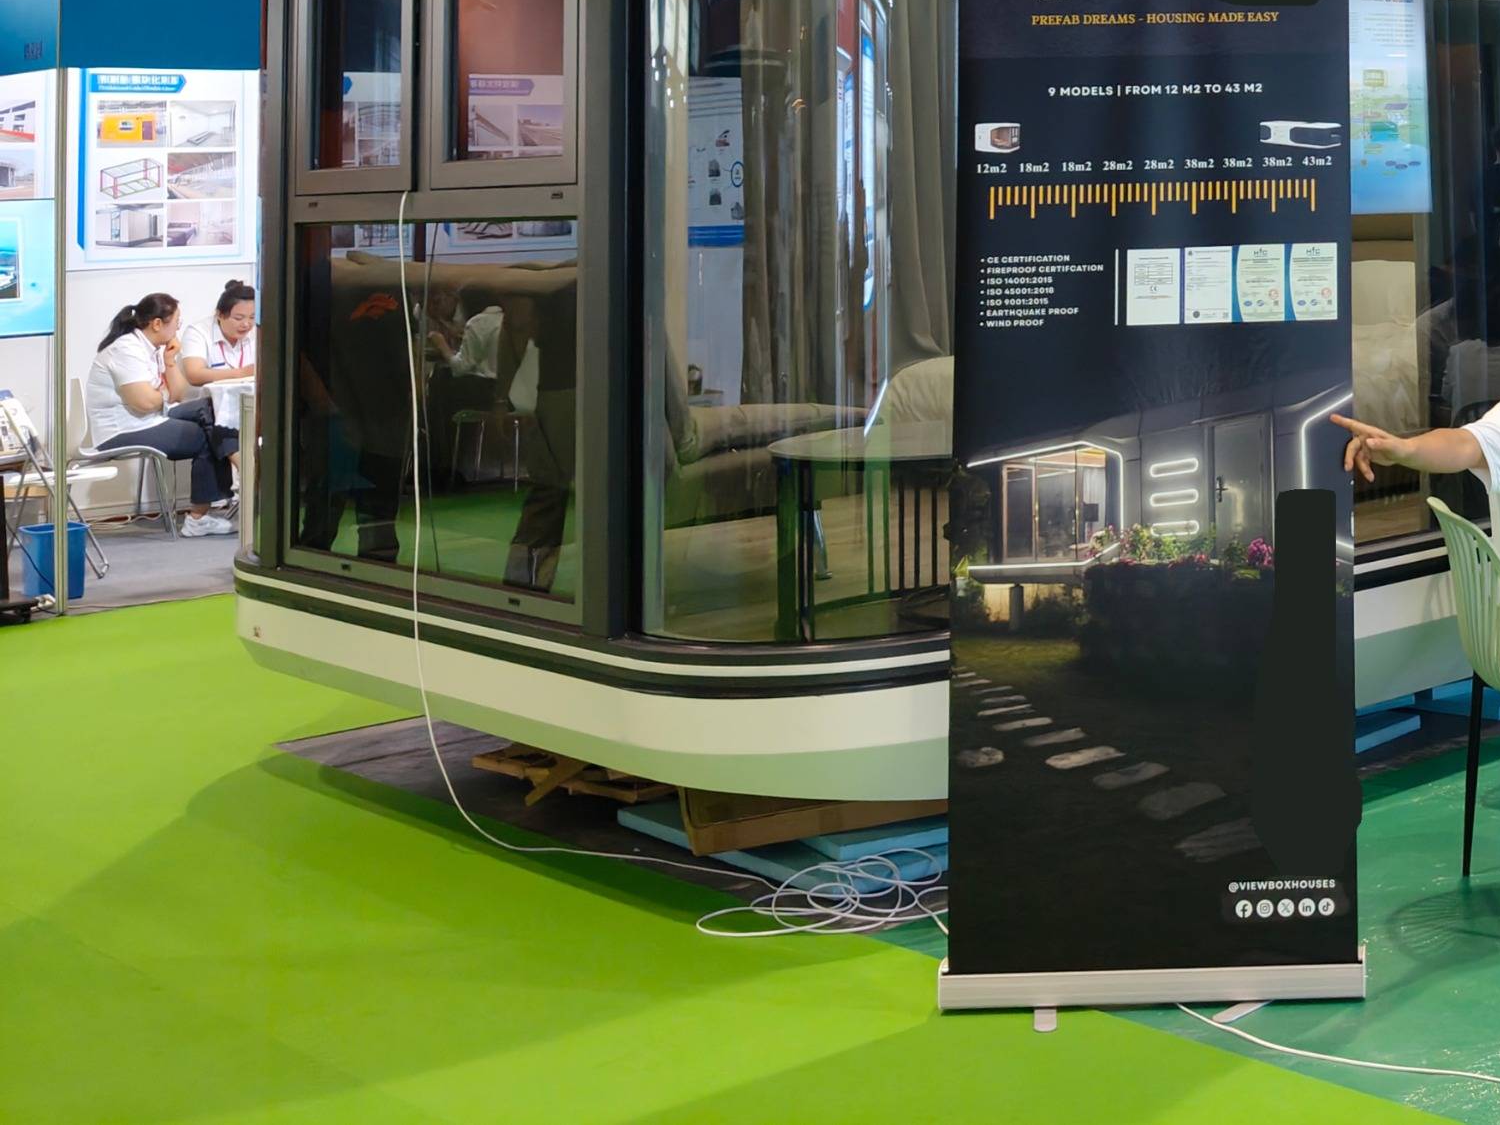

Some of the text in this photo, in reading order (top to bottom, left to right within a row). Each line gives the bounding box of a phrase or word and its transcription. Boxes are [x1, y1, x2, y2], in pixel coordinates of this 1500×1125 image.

[1031, 14, 1081, 26] PREFAB
[1083, 13, 1136, 25] DREAMS
[1146, 12, 1205, 24] HOUSING
[1208, 11, 1245, 23] MADE
[1247, 11, 1280, 23] EASY
[1048, 86, 1056, 97] 9
[1059, 85, 1114, 97] MODELS
[1125, 84, 1162, 95] FROM
[1164, 84, 1179, 95] 12
[1182, 83, 1201, 94] M2
[1204, 83, 1221, 94] TO
[1225, 83, 1241, 93] 43
[1244, 82, 1263, 93] M2
[976, 155, 1332, 174] 12m2 18m2 18m2 28m2 28m2 38m2 38m2 38m2 43m2
[986, 254, 1071, 264] CE CERTIFICATION
[986, 264, 1104, 274] FIREPROOF CERTIFCATION
[986, 276, 1054, 285] ISO 14001:2015
[1004, 286, 1055, 295] 45001:2018
[986, 297, 1049, 306] ISO 9001:2015
[986, 307, 1080, 317] EARTHQUAKE PROOF
[986, 318, 1045, 328] WIND PROOF
[1228, 879, 1336, 894] @VIEWBOXHOUSES
